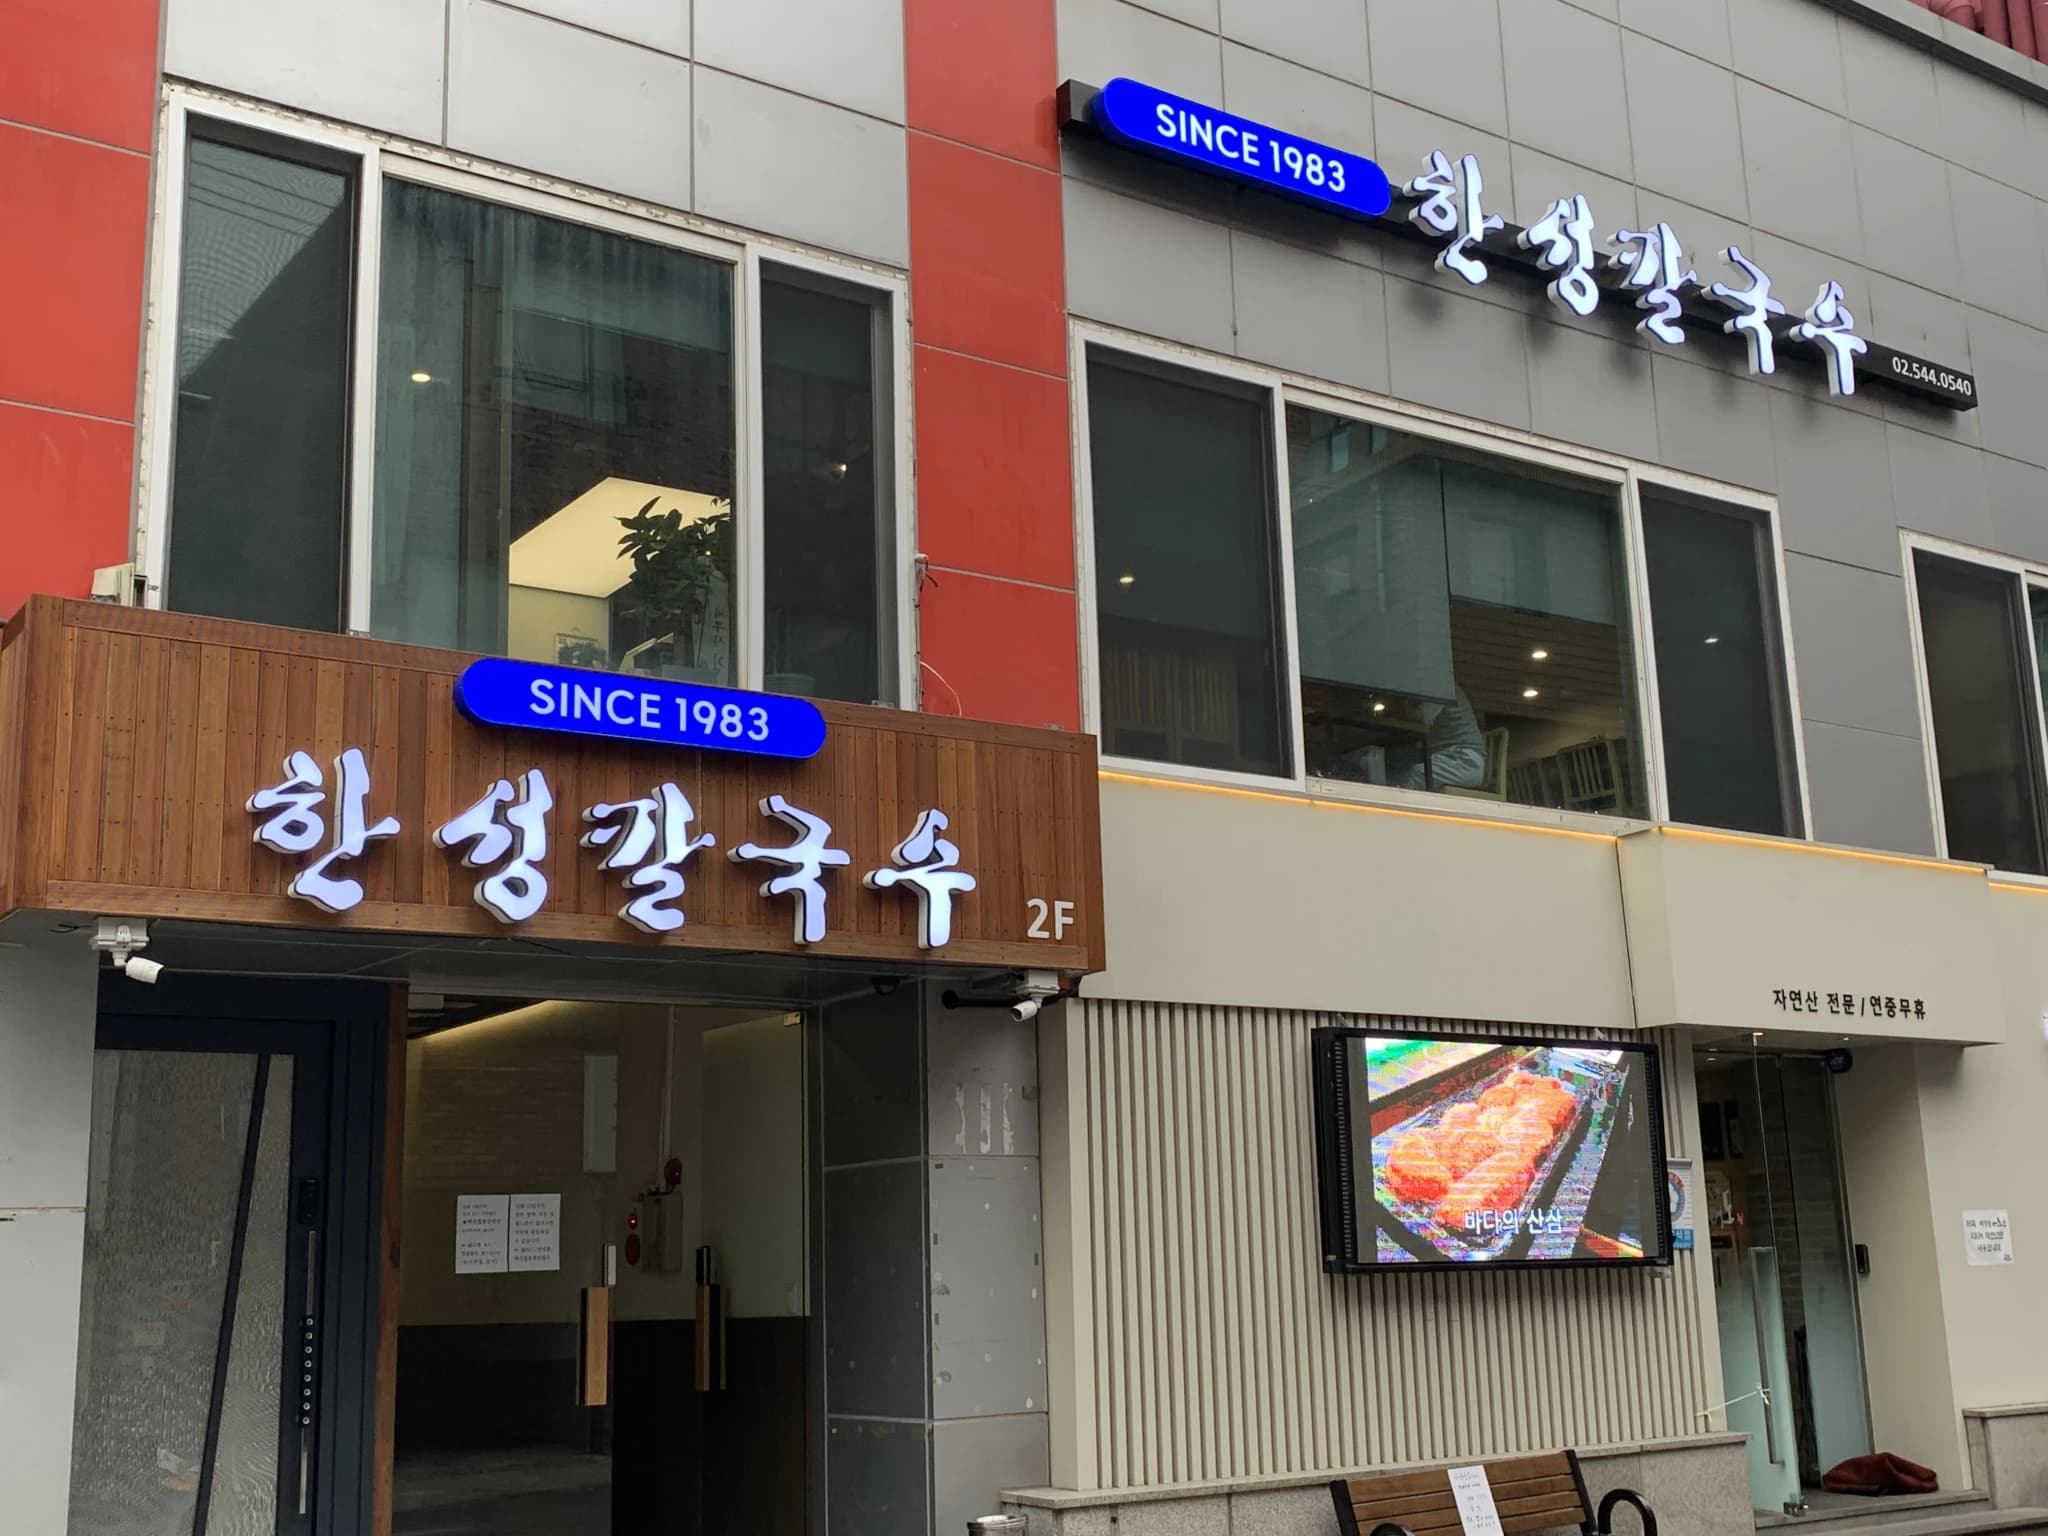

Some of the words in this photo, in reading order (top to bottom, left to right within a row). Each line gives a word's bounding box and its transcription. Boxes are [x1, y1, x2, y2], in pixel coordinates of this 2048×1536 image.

[1156, 104, 1260, 166] SINCE
[1269, 141, 1346, 192] 1983
[1892, 355, 1973, 397] 02.544.0540
[529, 678, 661, 729] SINCE
[675, 698, 769, 741] 1983
[1027, 898, 1075, 940] 2F
[1773, 989, 1818, 1013] 자연산
[1464, 1208, 1519, 1234] 바다의
[1526, 1208, 1563, 1234] 산삼
